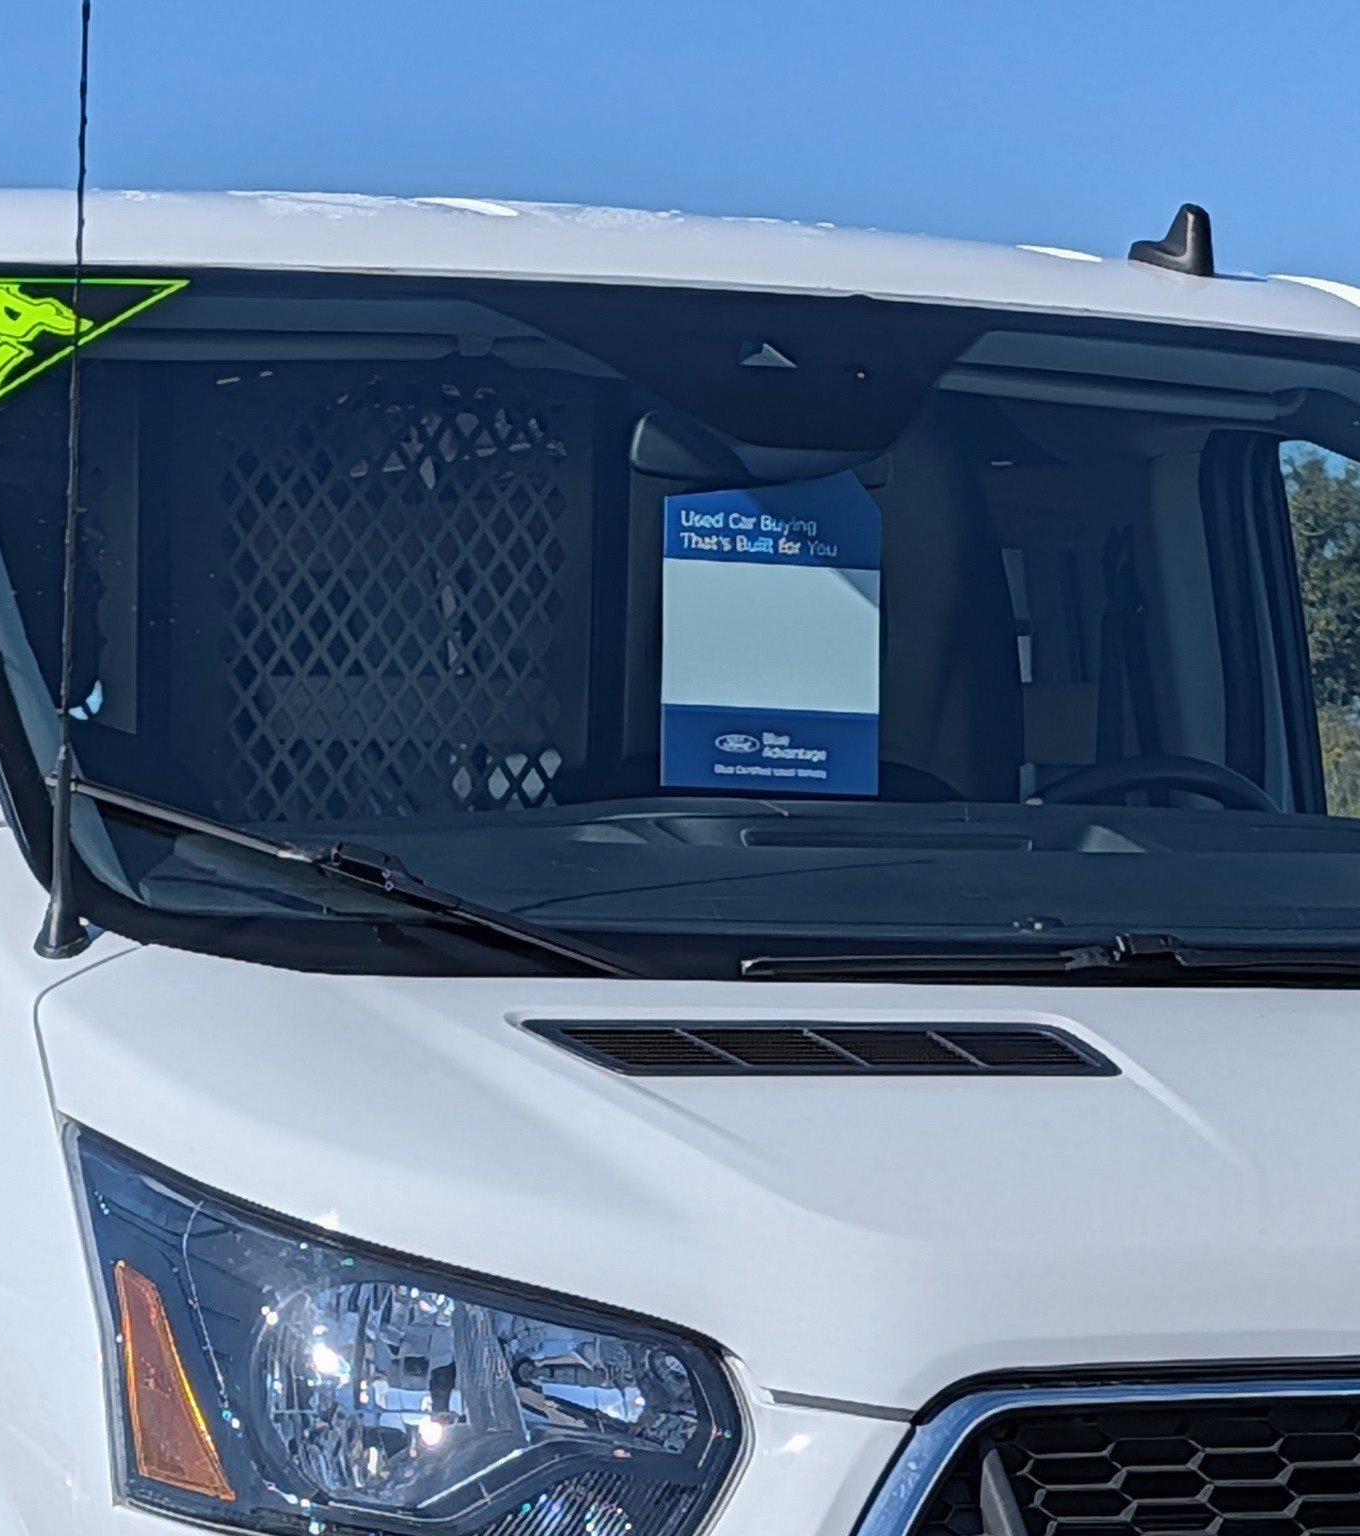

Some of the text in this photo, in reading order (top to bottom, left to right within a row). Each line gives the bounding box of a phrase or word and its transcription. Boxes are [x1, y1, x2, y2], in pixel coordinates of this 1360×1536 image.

[681, 510, 817, 536] Used Car Buying
[680, 532, 837, 557] That's Built for You
